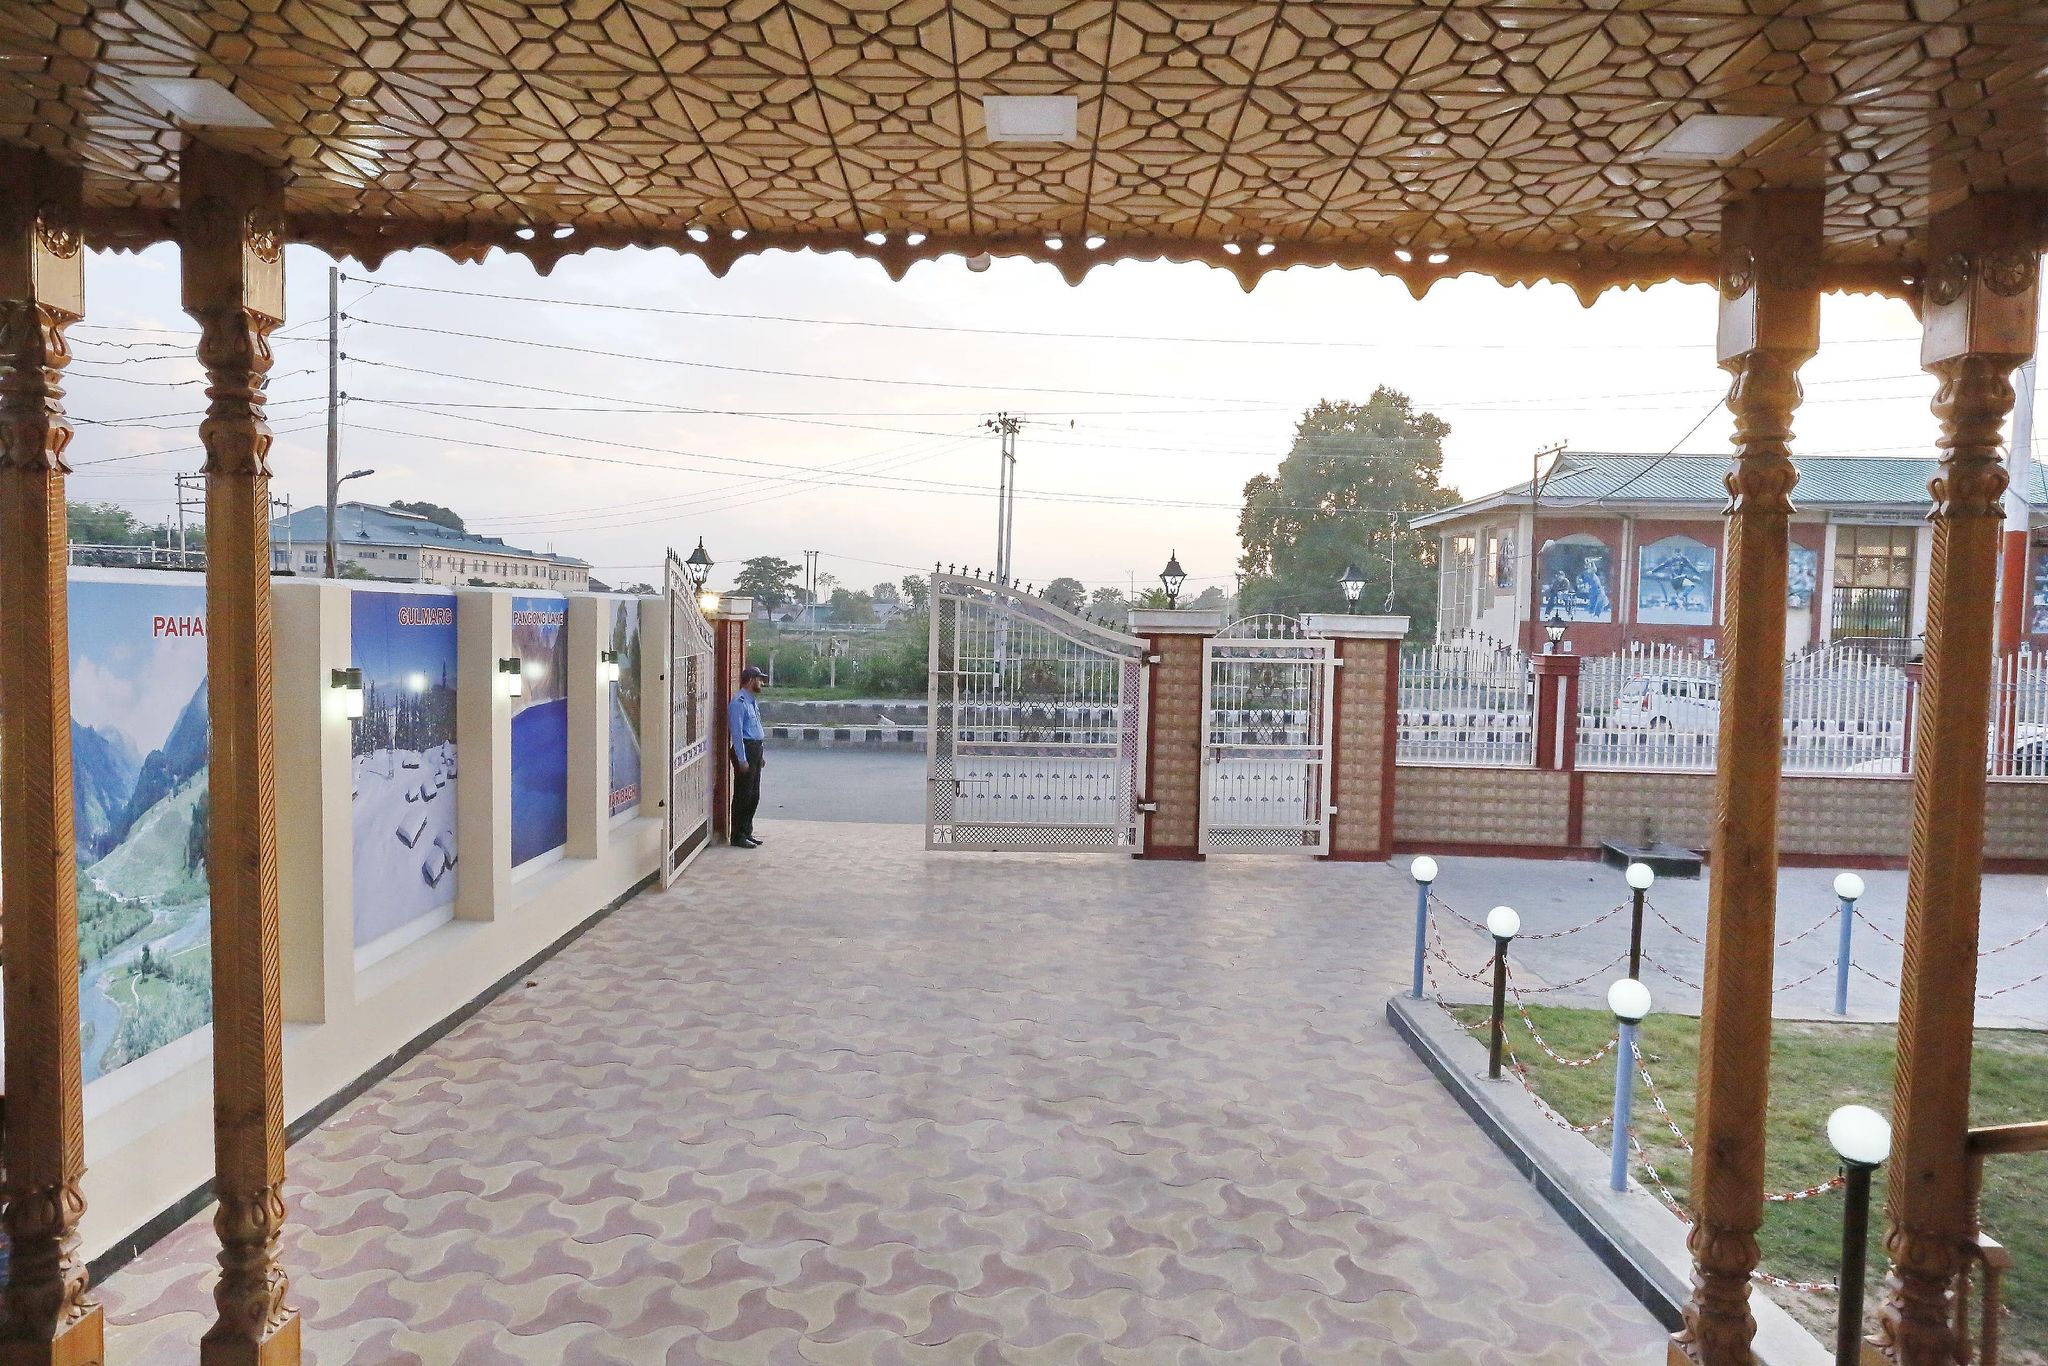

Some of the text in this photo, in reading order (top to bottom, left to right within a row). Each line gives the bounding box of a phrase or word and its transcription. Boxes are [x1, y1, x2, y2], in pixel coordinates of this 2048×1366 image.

[399, 607, 452, 625] GULMARG
[547, 611, 564, 625] LAKE
[153, 615, 209, 637] PAHA
